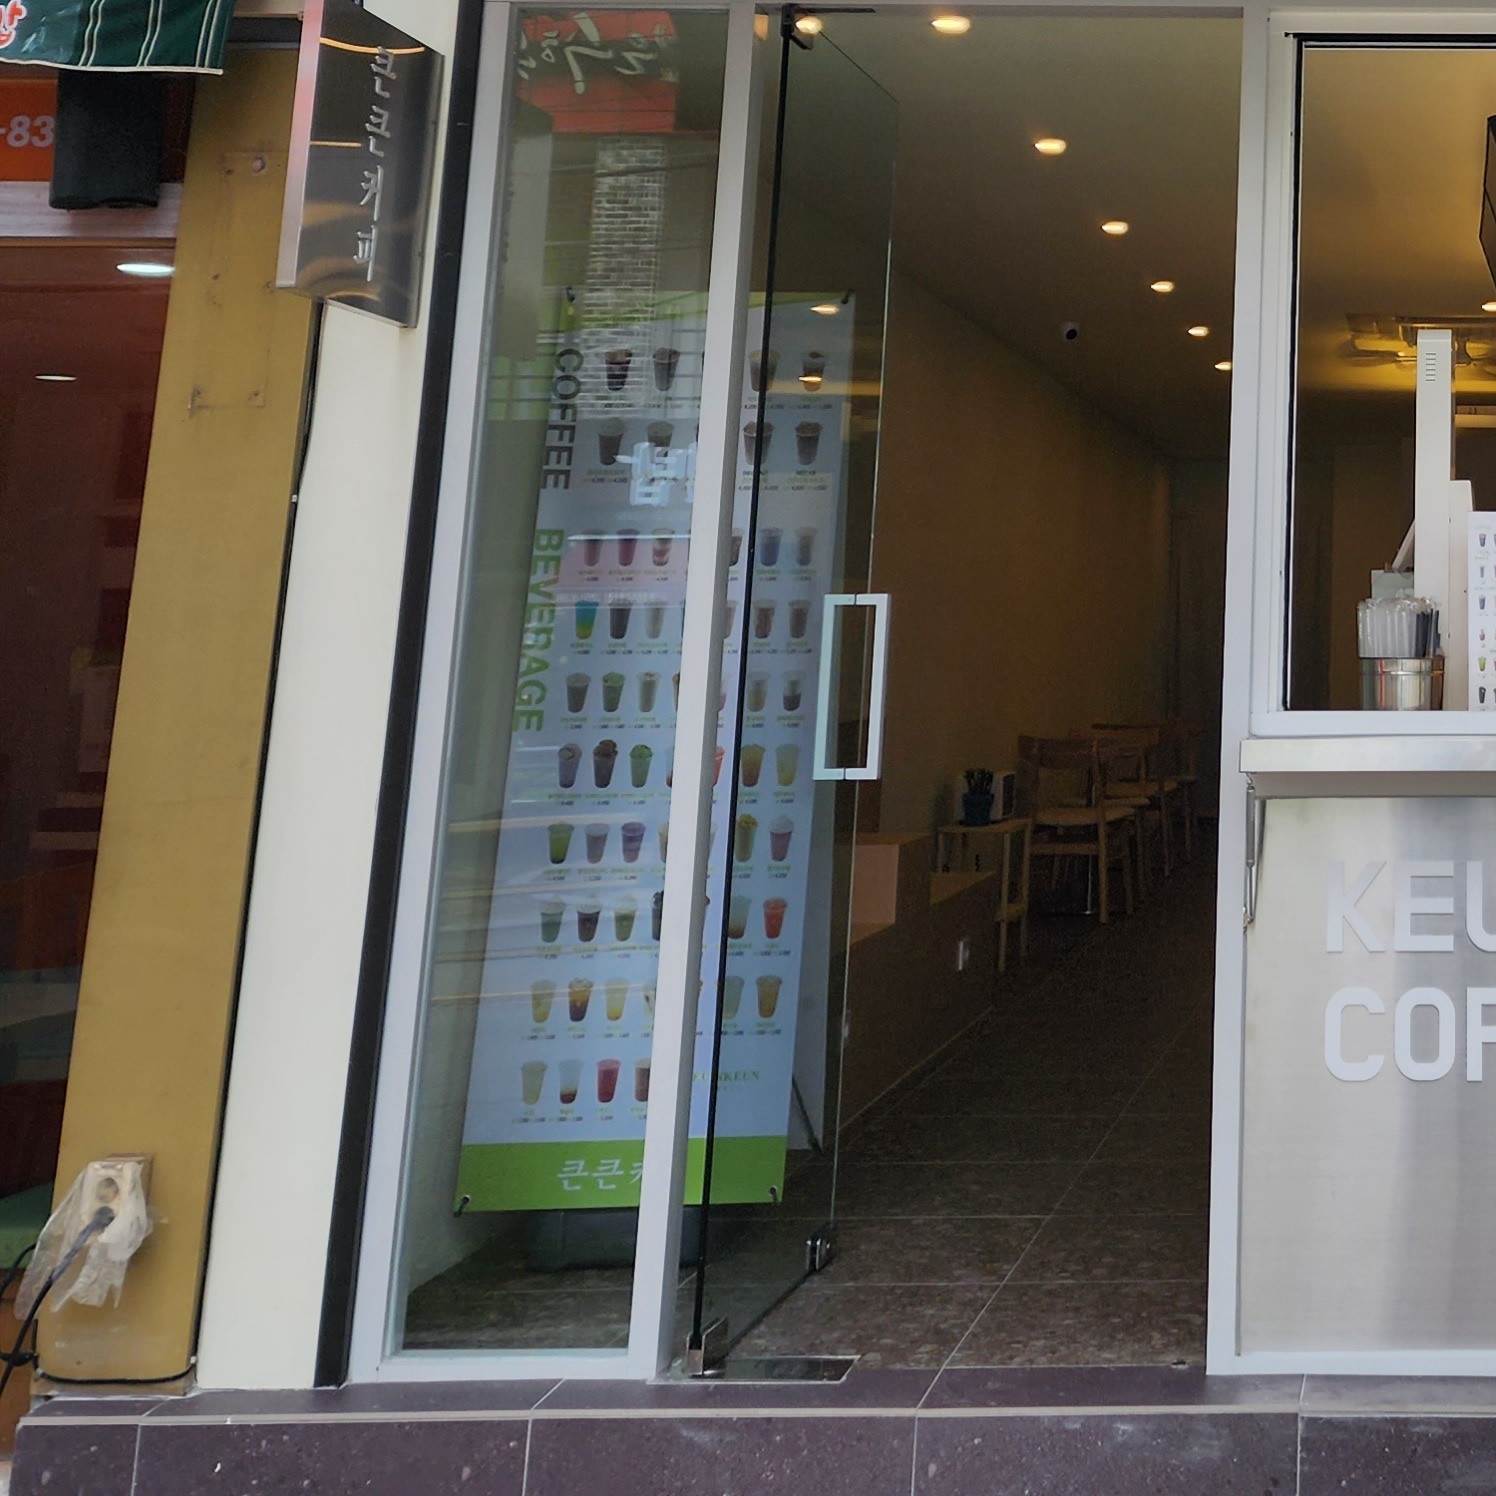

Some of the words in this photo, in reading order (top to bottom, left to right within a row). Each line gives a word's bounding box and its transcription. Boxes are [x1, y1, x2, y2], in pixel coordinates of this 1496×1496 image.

[352, 45, 397, 282] 큰큰커피
[540, 348, 584, 490] COFFEE
[512, 529, 565, 732] BEVERAGE
